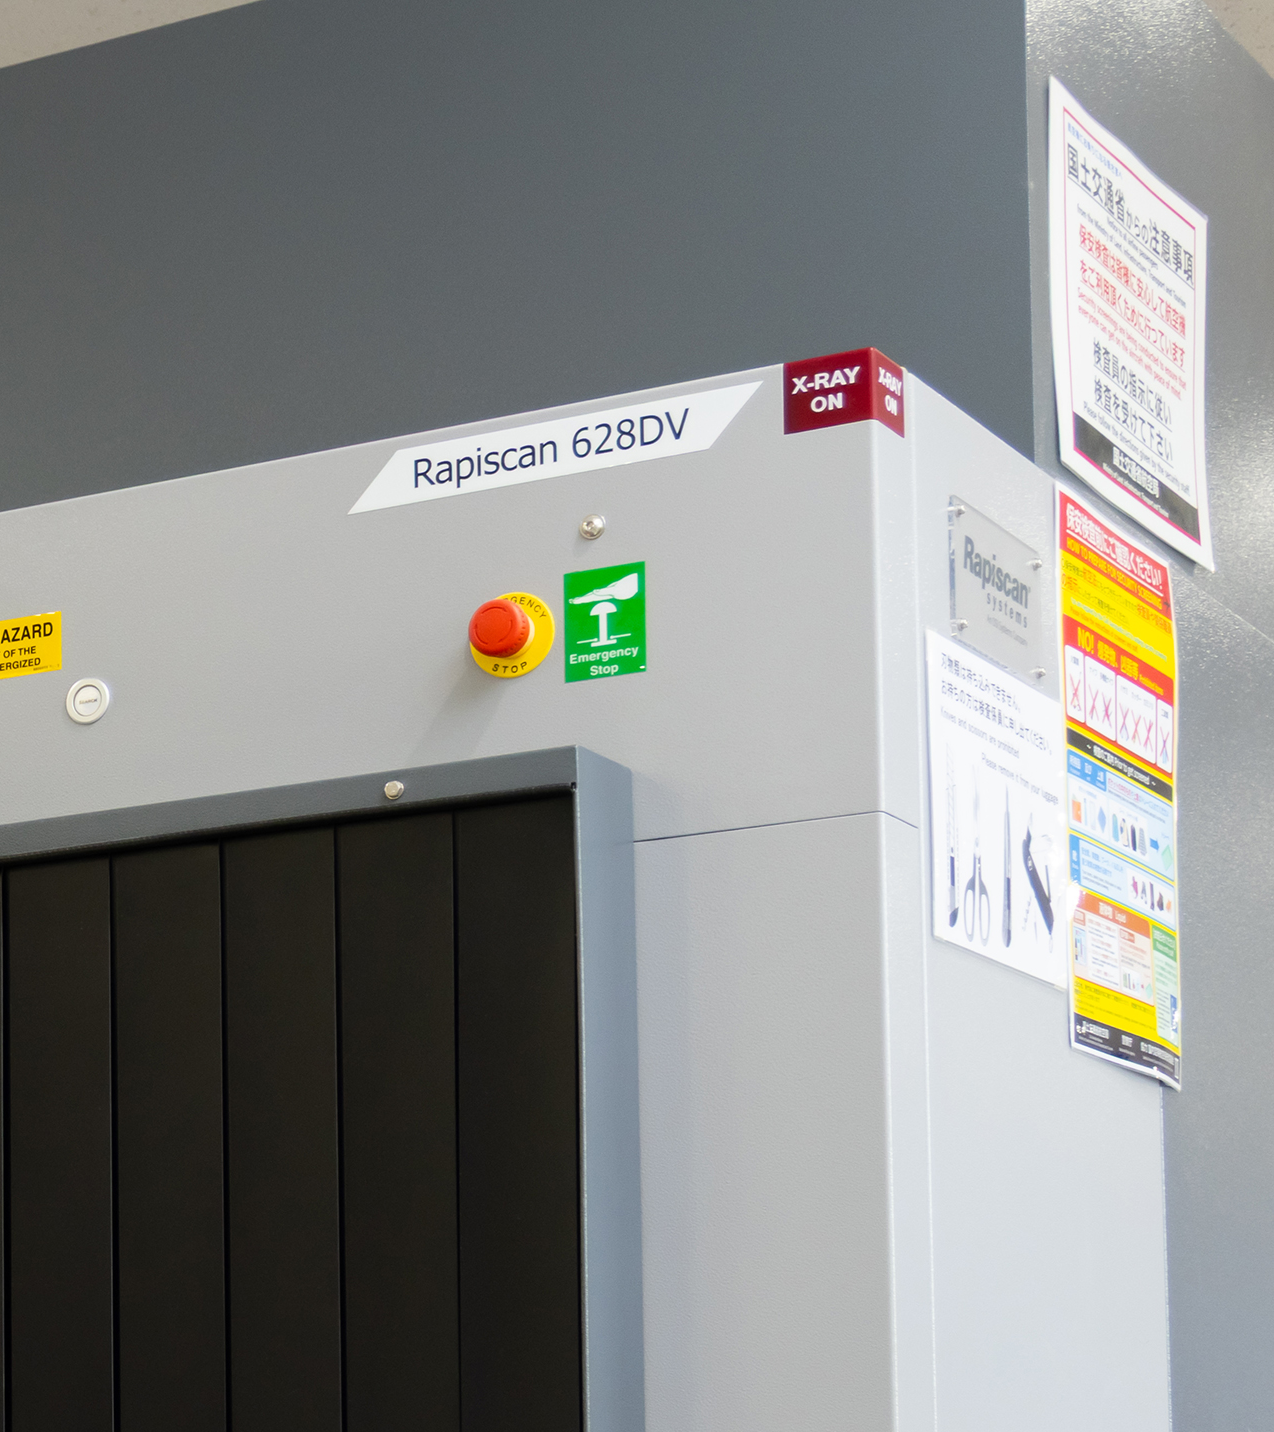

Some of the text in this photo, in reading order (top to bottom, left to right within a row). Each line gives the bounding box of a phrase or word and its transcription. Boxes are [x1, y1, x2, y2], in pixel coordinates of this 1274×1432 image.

[1068, 142, 1194, 284] 国土交通省からの注意事項
[1079, 222, 1185, 338] 保安検査は皆様に安心して航空機
[1080, 257, 1185, 370] をご利用頂くために行っています
[791, 366, 861, 395] X-RAY
[810, 392, 843, 413] ON
[878, 366, 902, 396] X-RAY
[1093, 336, 1171, 428] 検査員の指示に従い
[884, 395, 898, 416] ON
[1083, 401, 1096, 420] Please
[1094, 374, 1172, 464] 検査を受けて下さい
[413, 407, 690, 488] Rapiscan 628DV
[963, 535, 1029, 609] Rapiscan
[1067, 536, 1079, 556] HOW
[1080, 544, 1087, 560] TO
[1116, 568, 1137, 596] SECURITY
[504, 595, 548, 619] GENCY
[986, 592, 1028, 628] systems
[3, 649, 16, 660] OF
[18, 646, 37, 656] THE
[569, 646, 640, 665] Emergency
[1077, 625, 1094, 655] NO!
[491, 660, 528, 674] STOP
[590, 664, 619, 677] Stop
[941, 651, 1020, 713] 刃物類は持ち込みできません。
[940, 705, 955, 723] Knives
[968, 722, 987, 740] scissors
[997, 738, 1019, 759] prohibited
[941, 679, 1051, 756] お持ちの方は検査係員に申し出てください。
[981, 752, 996, 769] Please
[998, 763, 1014, 779] remove
[1019, 774, 1028, 788] from
[1030, 782, 1039, 796] your
[1041, 788, 1058, 806] luggage
